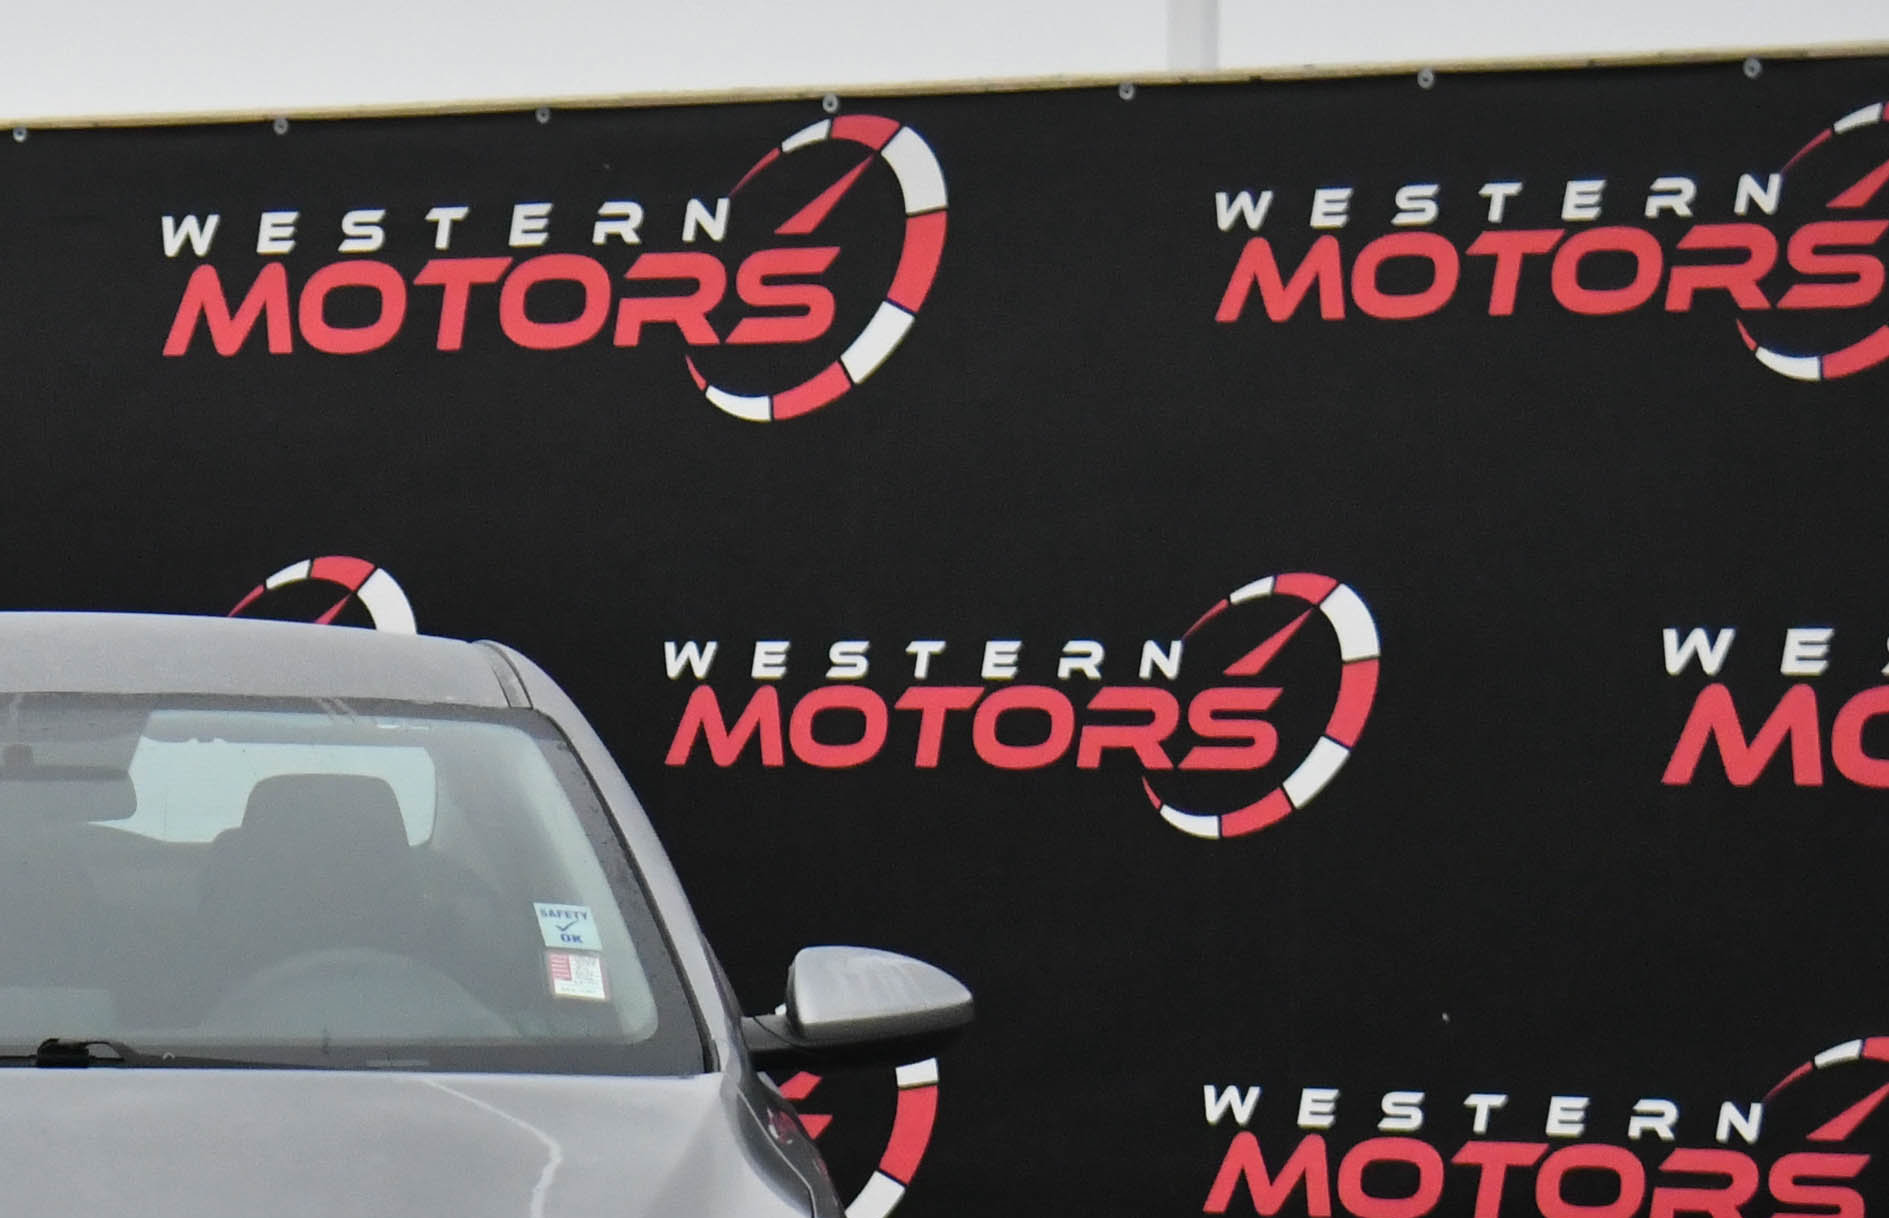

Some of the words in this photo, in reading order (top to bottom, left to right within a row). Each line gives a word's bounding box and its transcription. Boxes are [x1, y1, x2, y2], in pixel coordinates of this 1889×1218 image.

[162, 198, 730, 257] WESTERN
[1215, 173, 1781, 231] WESTERN
[1215, 220, 1889, 323] MOTORS
[164, 252, 840, 357] MOTORS
[665, 640, 1183, 679] WESTERN
[665, 684, 1283, 771] MOTORS
[539, 908, 588, 920] SAFETY
[560, 933, 583, 943] OK
[1203, 1084, 1763, 1143] WESTERN
